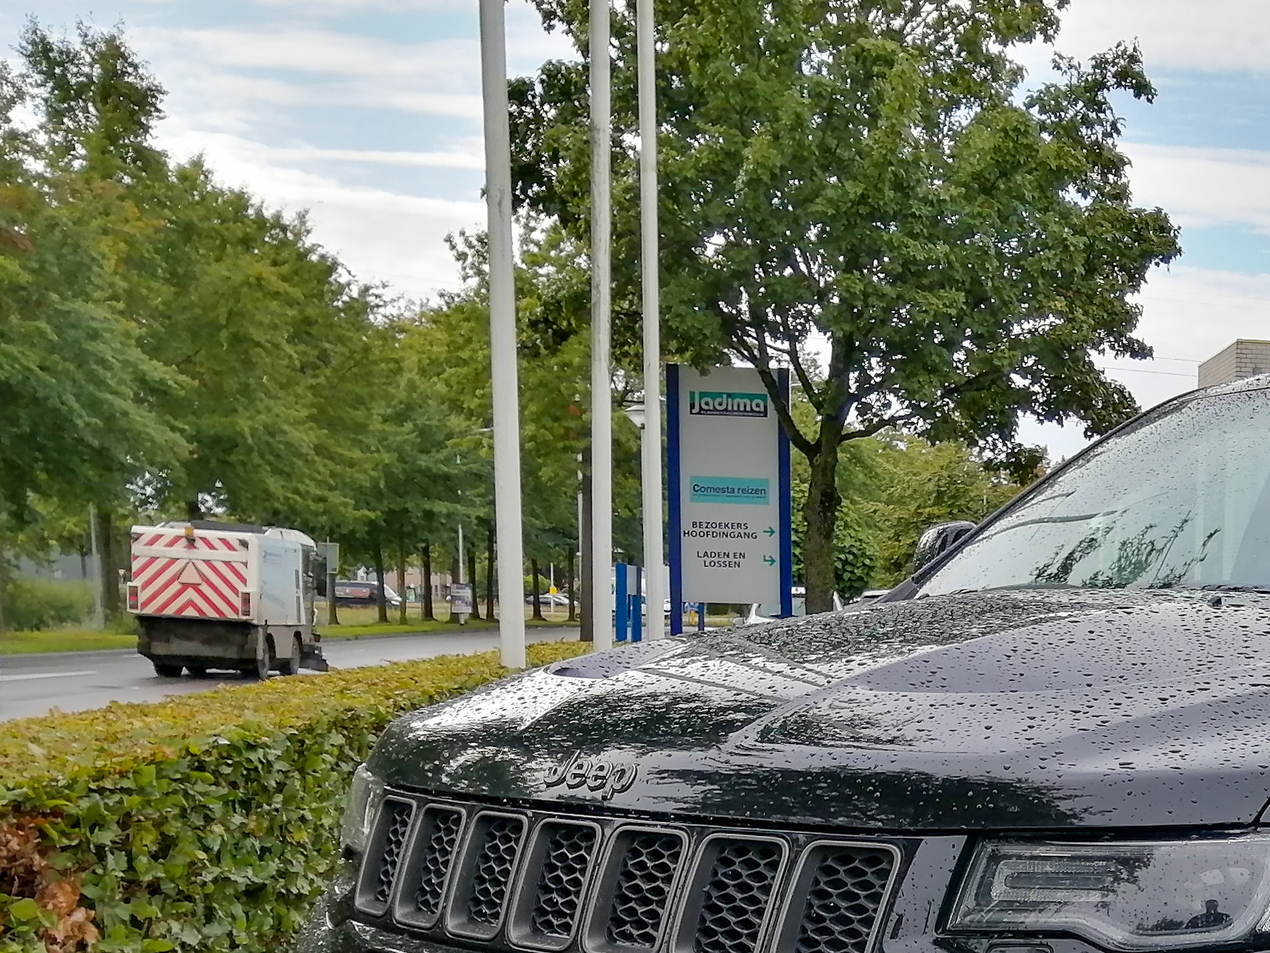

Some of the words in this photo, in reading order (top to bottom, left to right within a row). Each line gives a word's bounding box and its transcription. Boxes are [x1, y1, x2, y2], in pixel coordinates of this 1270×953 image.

[692, 390, 765, 413] Jadima
[692, 484, 735, 494] Comesta
[737, 486, 766, 495] reizen
[691, 521, 749, 530] BEZOEKERS
[683, 530, 758, 540] HOOFDINGANG
[696, 551, 730, 559] LADEN
[733, 552, 746, 560] EN
[703, 560, 741, 568] LOSSEN
[543, 749, 639, 801] Jeep
